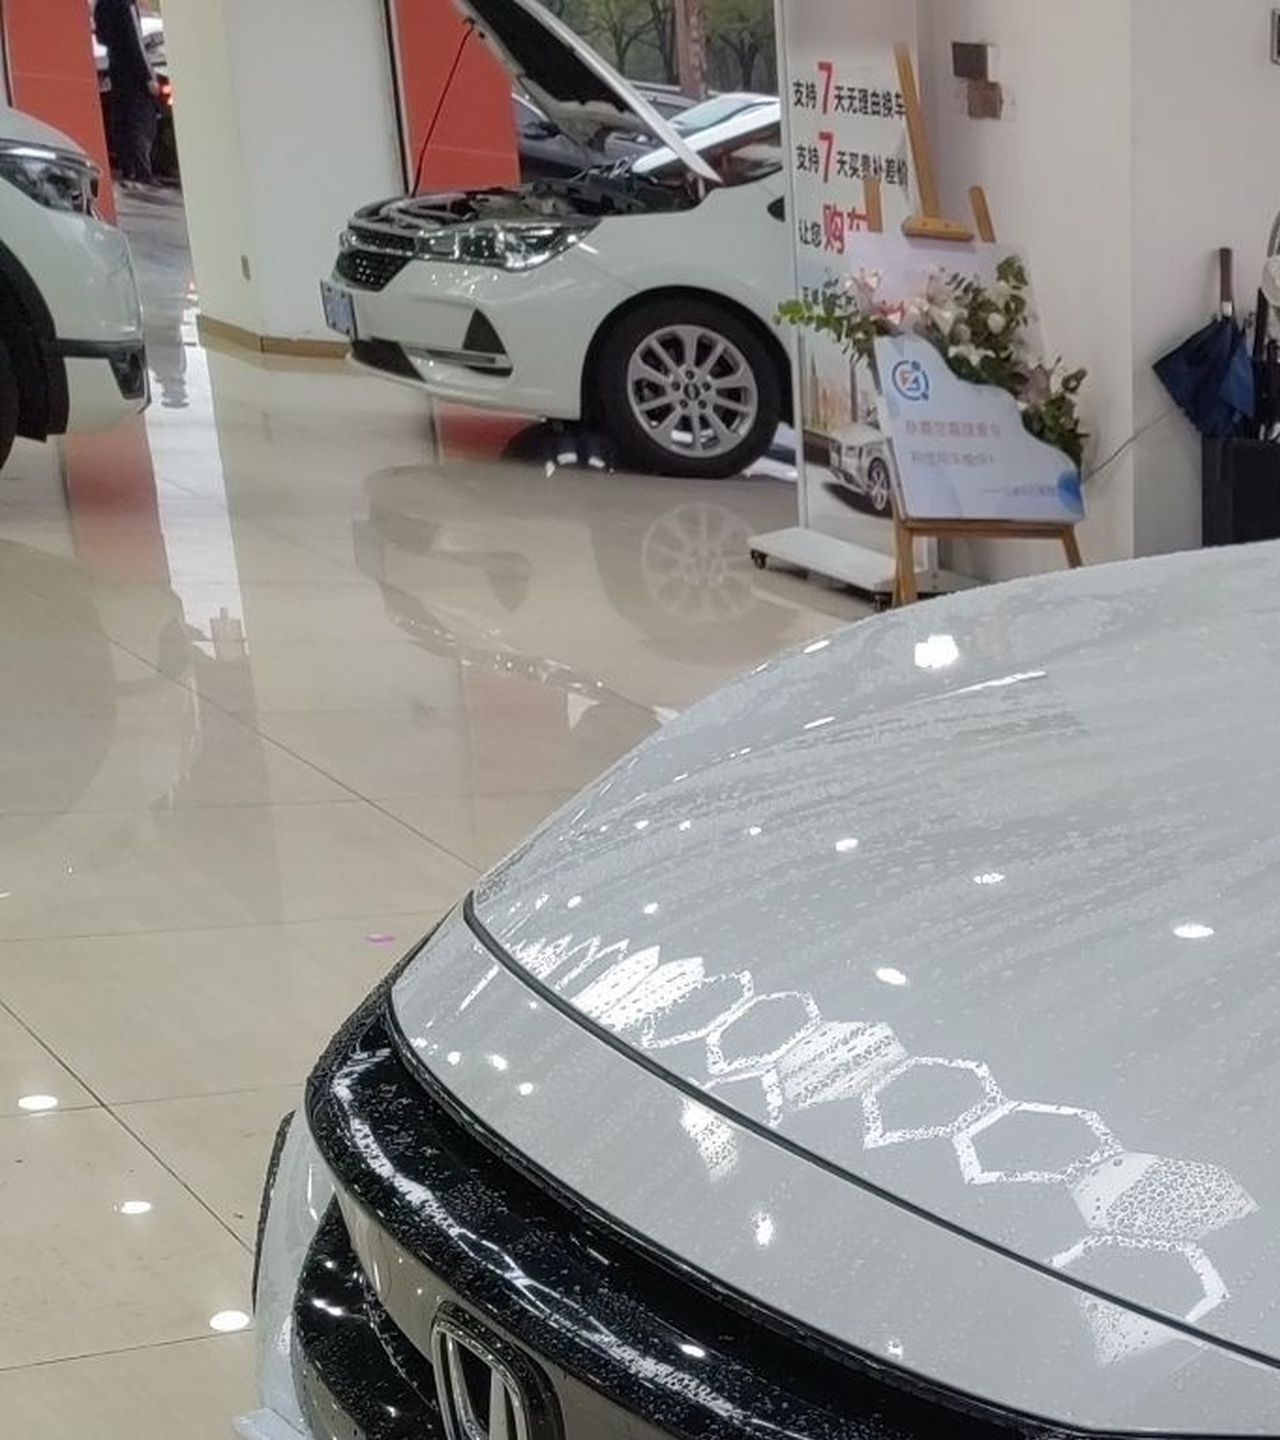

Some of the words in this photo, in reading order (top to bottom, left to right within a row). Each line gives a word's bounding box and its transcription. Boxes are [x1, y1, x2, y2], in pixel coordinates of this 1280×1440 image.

[793, 61, 906, 119] 支持7天无理由换车
